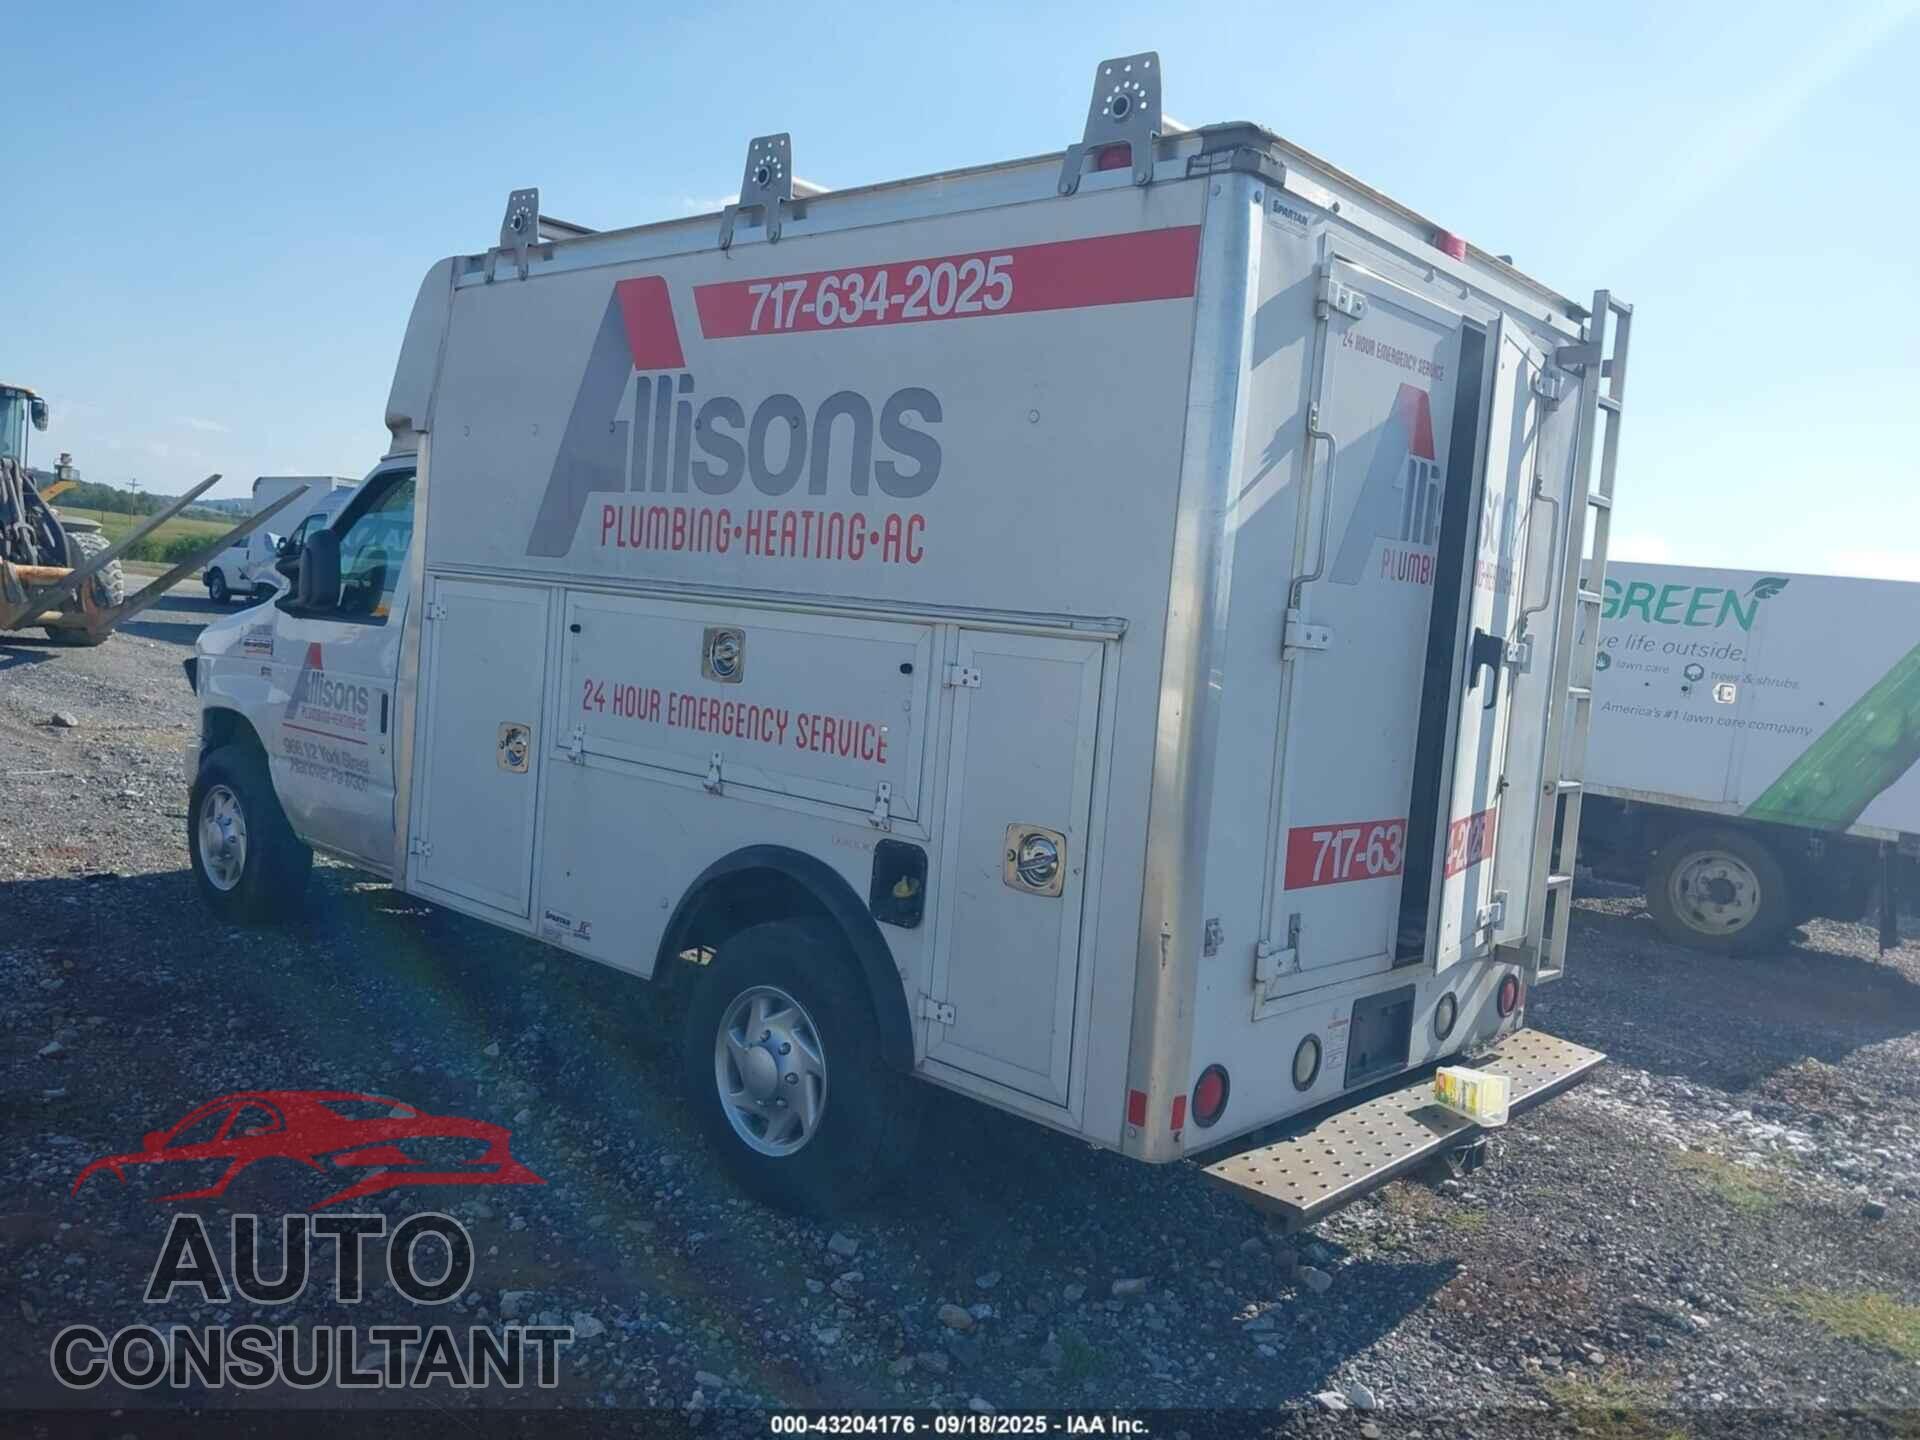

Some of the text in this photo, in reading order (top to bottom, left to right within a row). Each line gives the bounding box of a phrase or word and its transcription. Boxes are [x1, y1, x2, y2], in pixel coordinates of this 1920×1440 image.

[748, 254, 1014, 331] 717-634-2025
[1342, 332, 1445, 382] 24 HOUR EMERGENCY SERVICE
[525, 274, 943, 557] Allisons
[1328, 382, 1440, 585] Alli
[1579, 577, 1761, 632] GREEN
[1625, 633, 1656, 652] life
[1662, 641, 1748, 662] outside.
[583, 679, 888, 764] 24 HOUR EMERGENCY SERVICE
[1600, 701, 1661, 718] America's
[1682, 711, 1713, 725] lawn
[1716, 717, 1746, 728] care
[1748, 721, 1814, 737] company
[1311, 824, 1402, 882] 717-63
